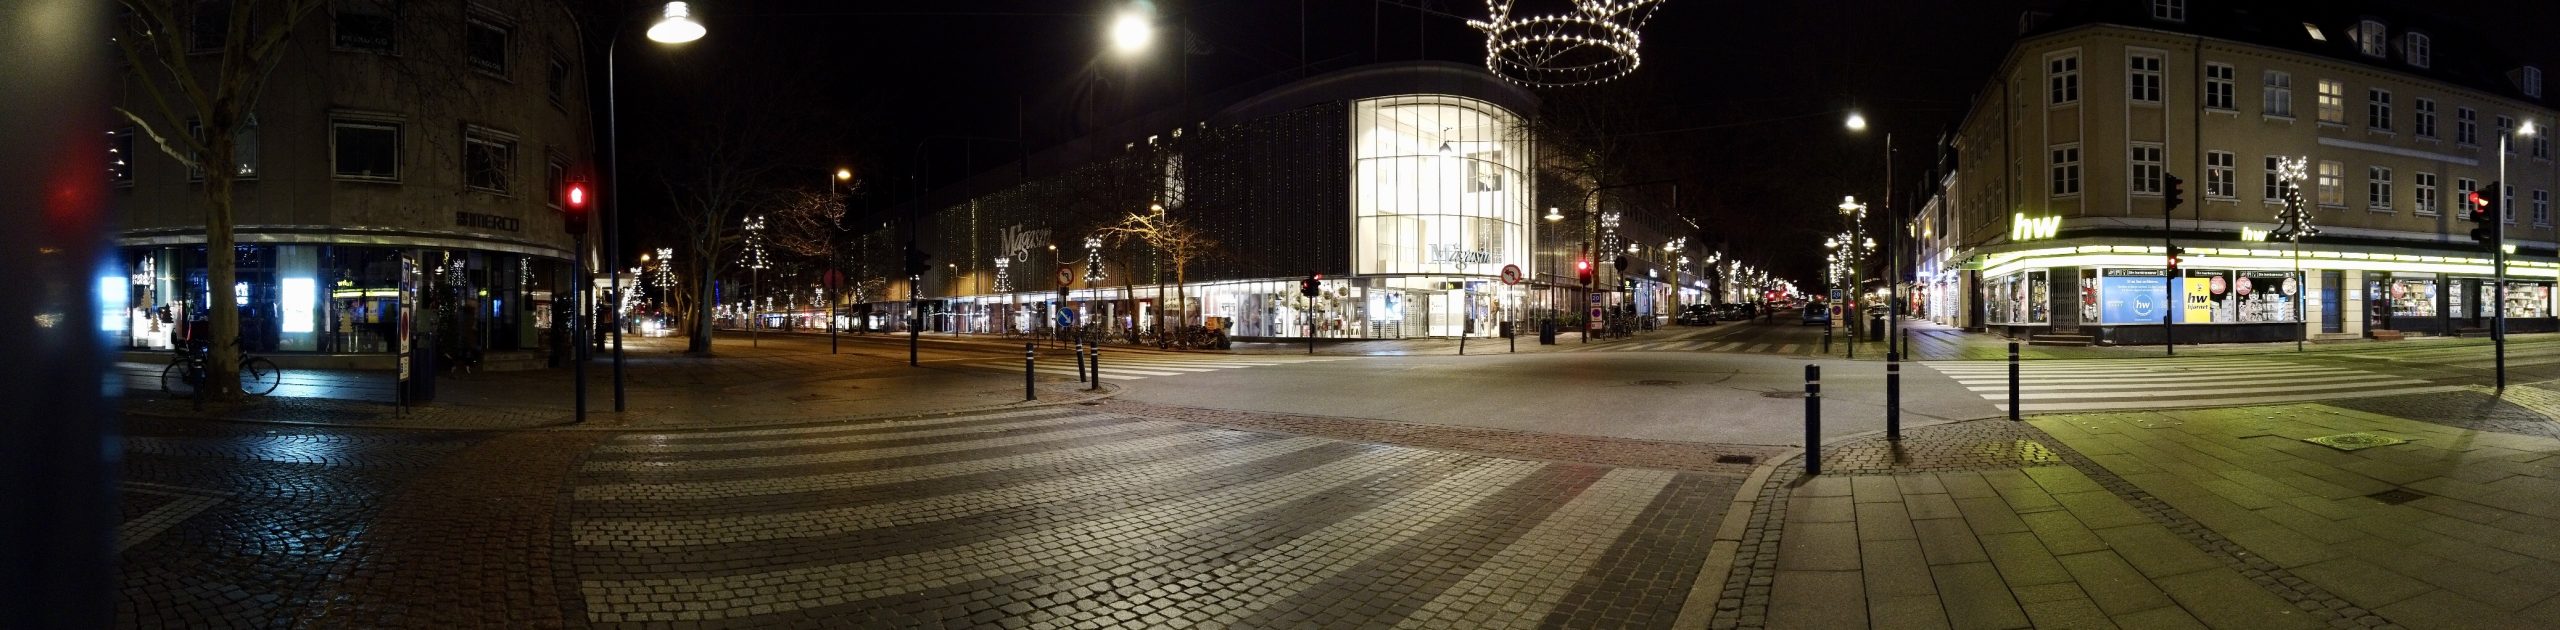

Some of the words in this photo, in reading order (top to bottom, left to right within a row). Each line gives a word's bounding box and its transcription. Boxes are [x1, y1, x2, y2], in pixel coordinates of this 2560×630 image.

[469, 213, 519, 232] IMERCO
[2012, 213, 2062, 241] hw
[1000, 221, 1052, 262] Magasin
[2241, 226, 2268, 241] hw
[1428, 243, 1490, 270] Magasin
[2136, 300, 2150, 309] hw
[2187, 292, 2208, 304] hw
